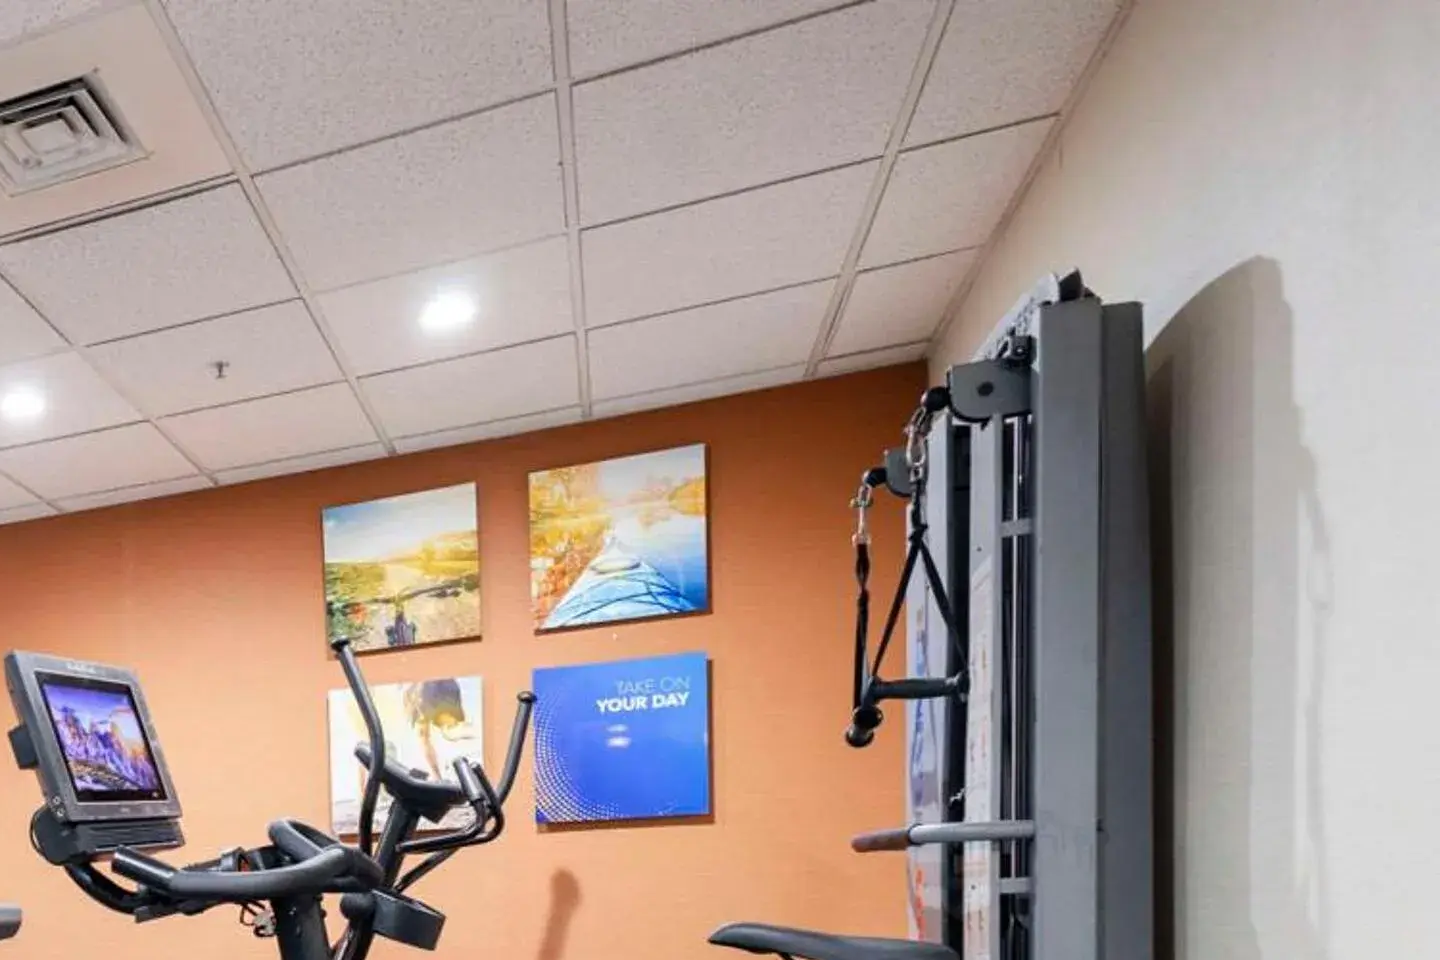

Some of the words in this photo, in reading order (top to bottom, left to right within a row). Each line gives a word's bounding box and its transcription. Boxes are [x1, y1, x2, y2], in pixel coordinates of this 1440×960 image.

[616, 679, 656, 694] TAKE
[661, 677, 690, 691] ON
[596, 695, 648, 713] YOUR
[652, 691, 690, 708] DAY
